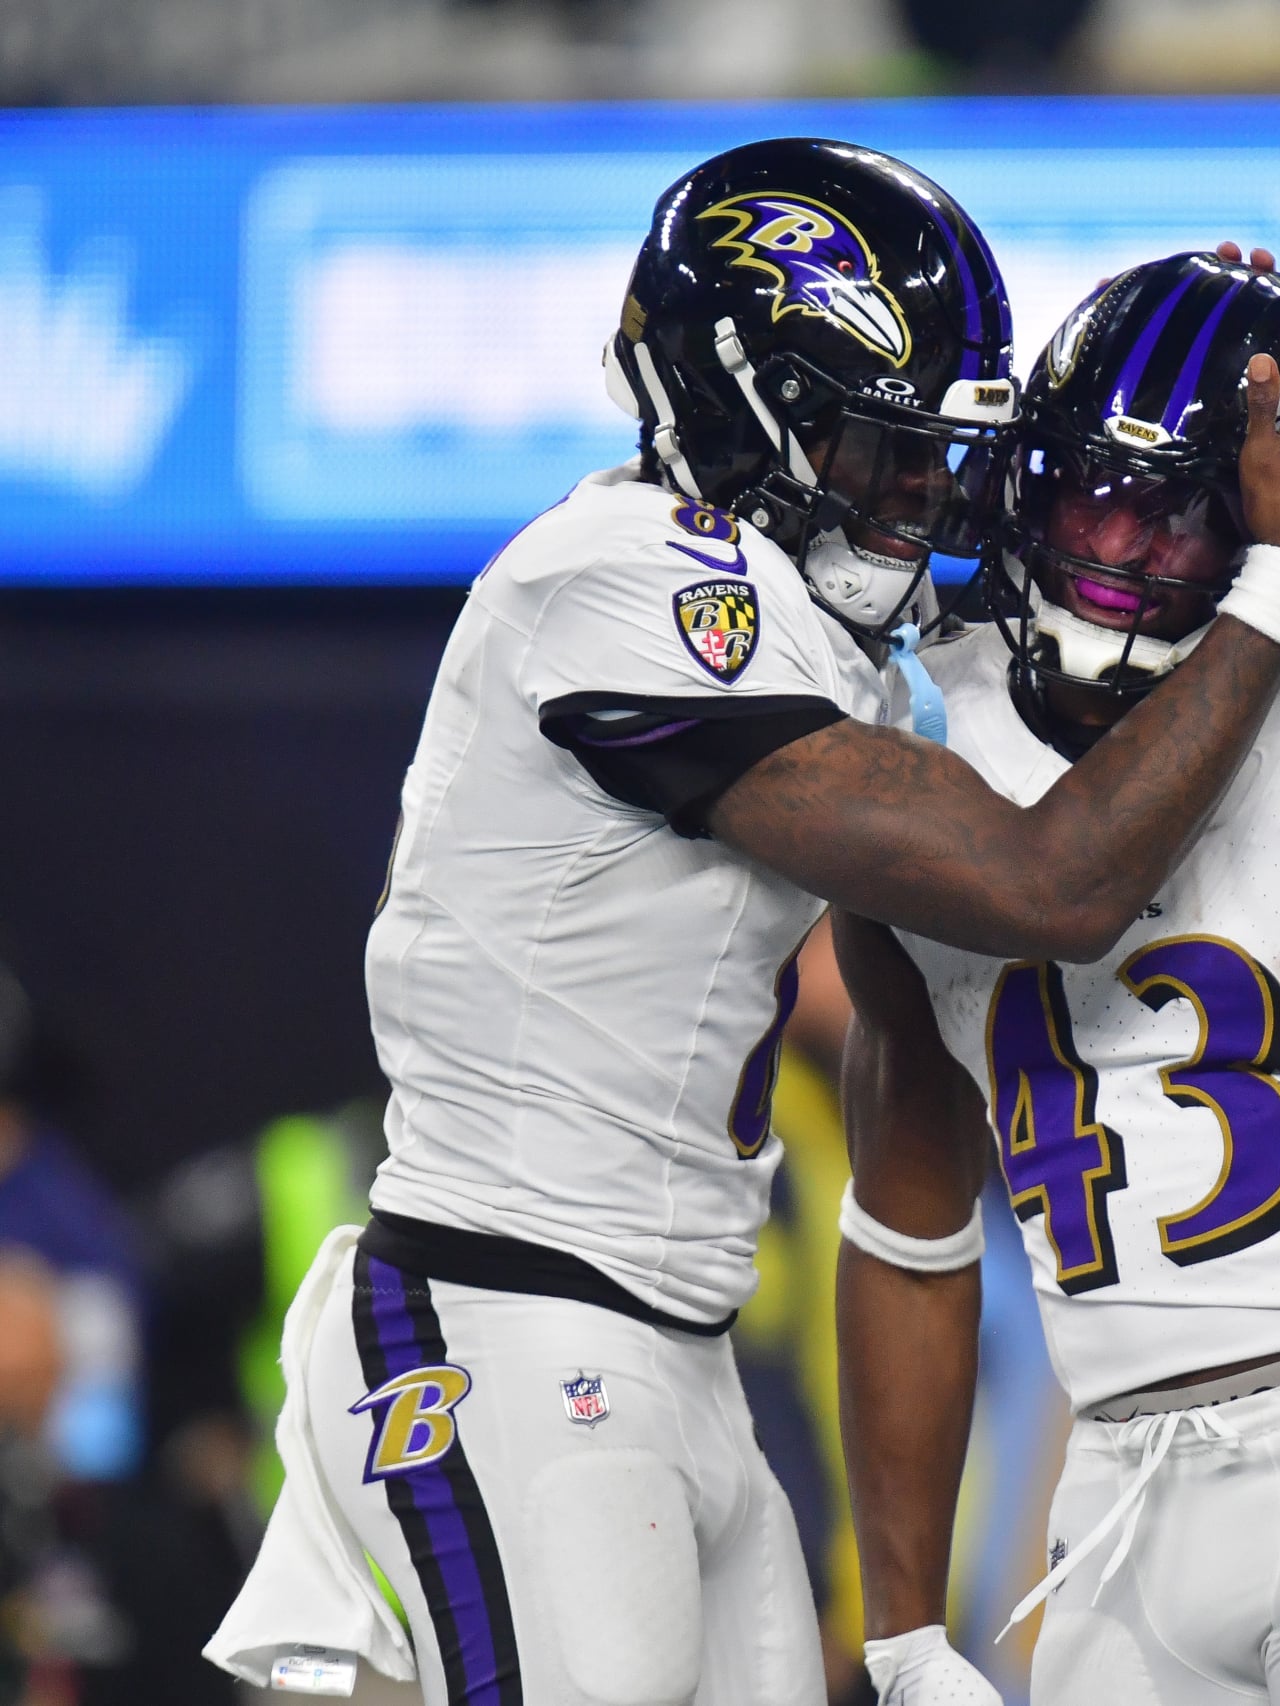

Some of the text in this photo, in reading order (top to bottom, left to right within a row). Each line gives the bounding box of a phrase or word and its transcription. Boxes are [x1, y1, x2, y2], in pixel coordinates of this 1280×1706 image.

[862, 386, 921, 408] OAKLEY
[1117, 419, 1159, 443] RAVENS
[678, 584, 750, 605] RAVENS
[572, 1394, 604, 1417] NFL
[347, 1362, 472, 1484] B
